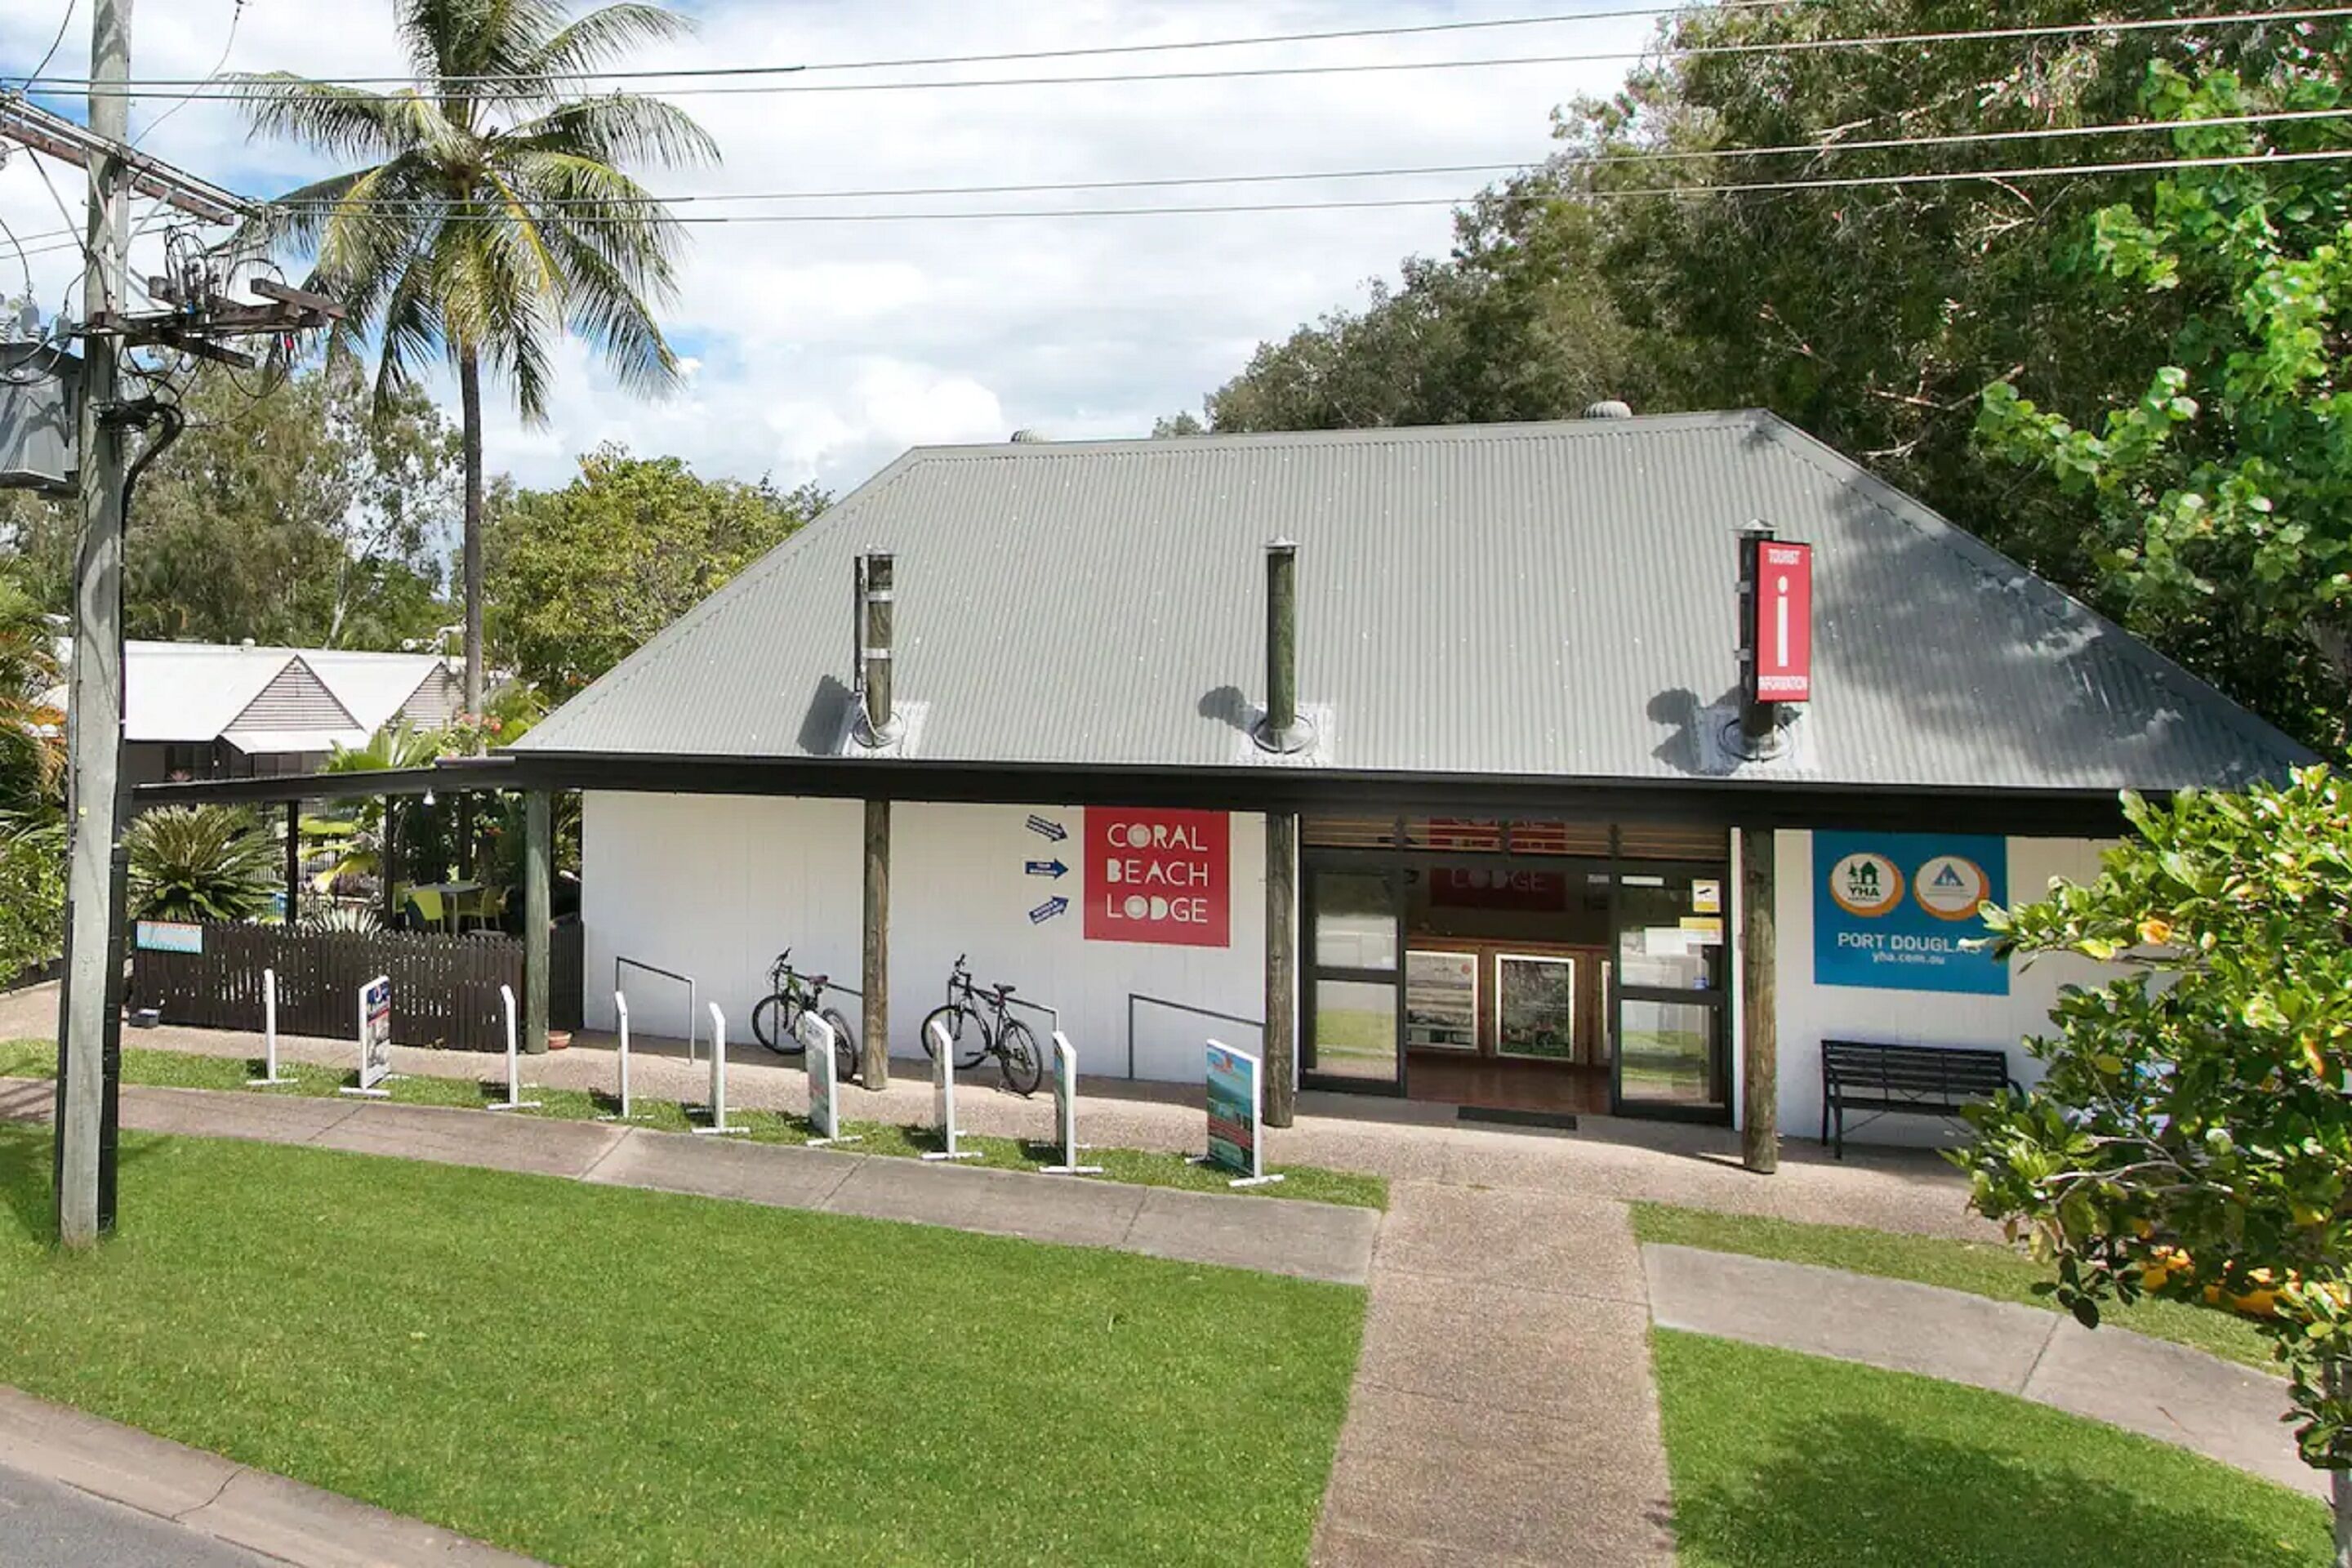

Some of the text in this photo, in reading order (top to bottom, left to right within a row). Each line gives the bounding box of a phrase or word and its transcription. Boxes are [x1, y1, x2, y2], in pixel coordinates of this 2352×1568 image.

[1107, 822, 1208, 852] CORAL
[1107, 858, 1208, 887] BEACH
[1451, 866, 1546, 892] LODGE
[1847, 885, 1881, 897] YHA
[1107, 894, 1208, 923] LODGE
[1838, 933, 1885, 949] PORT
[1873, 953, 1945, 965] yha.com.au
